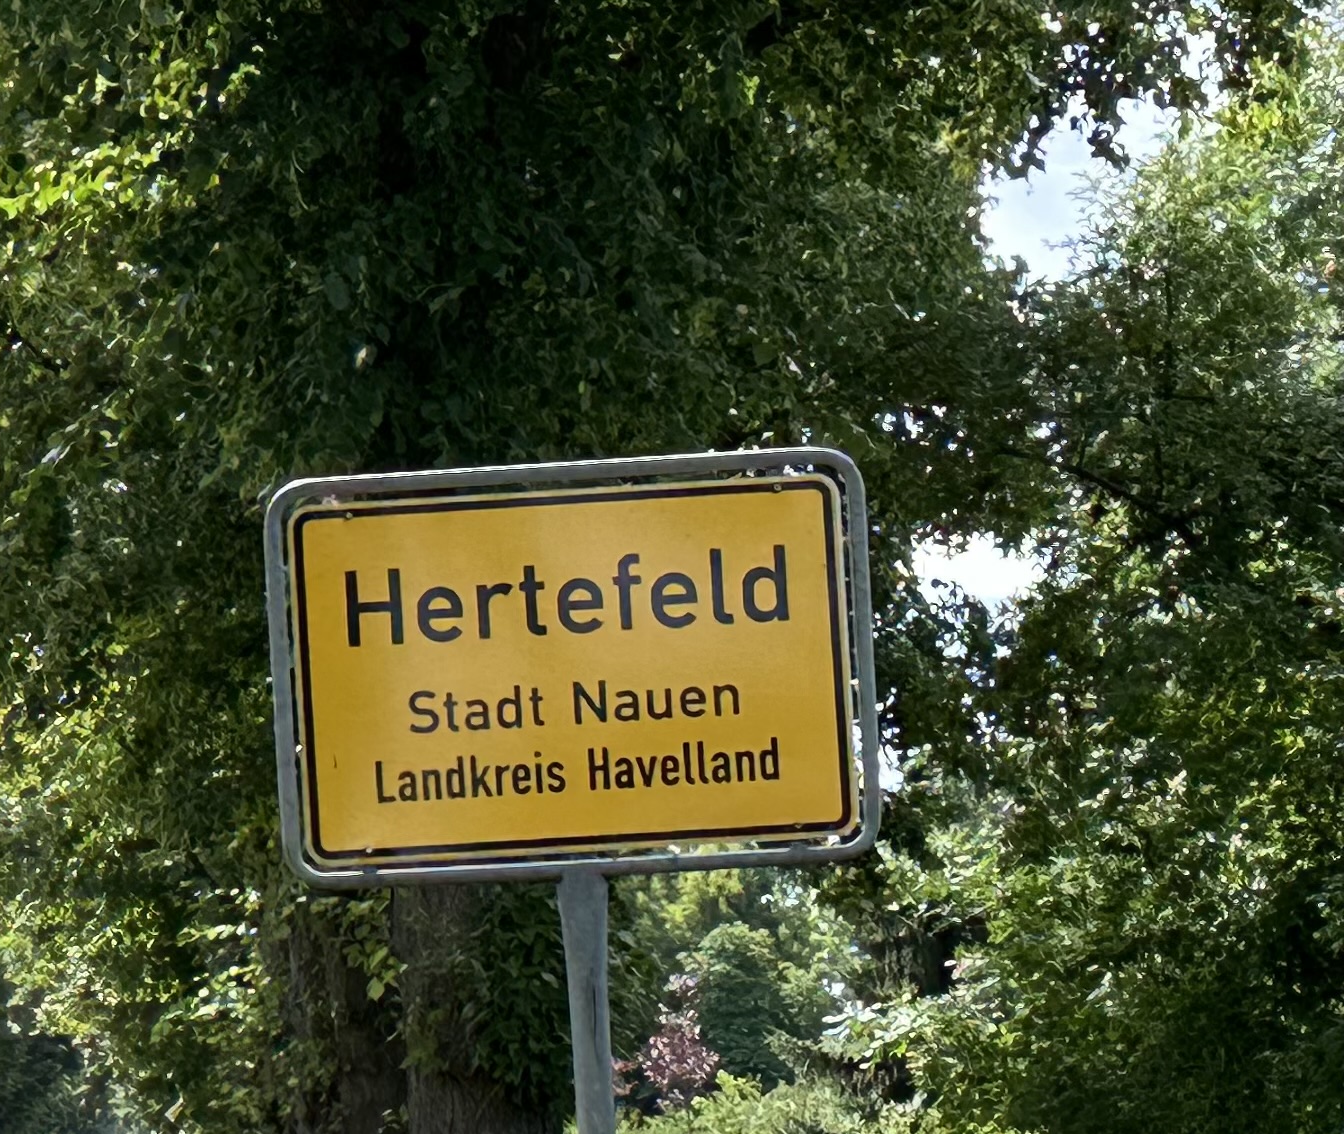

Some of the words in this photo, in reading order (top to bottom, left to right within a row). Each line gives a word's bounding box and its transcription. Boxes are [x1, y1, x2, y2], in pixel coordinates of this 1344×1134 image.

[344, 544, 790, 647] Hertefeld
[408, 685, 545, 734] Stadt
[572, 680, 740, 726] Nauen
[374, 751, 567, 804] Landkreis
[587, 736, 780, 791] Havelland
